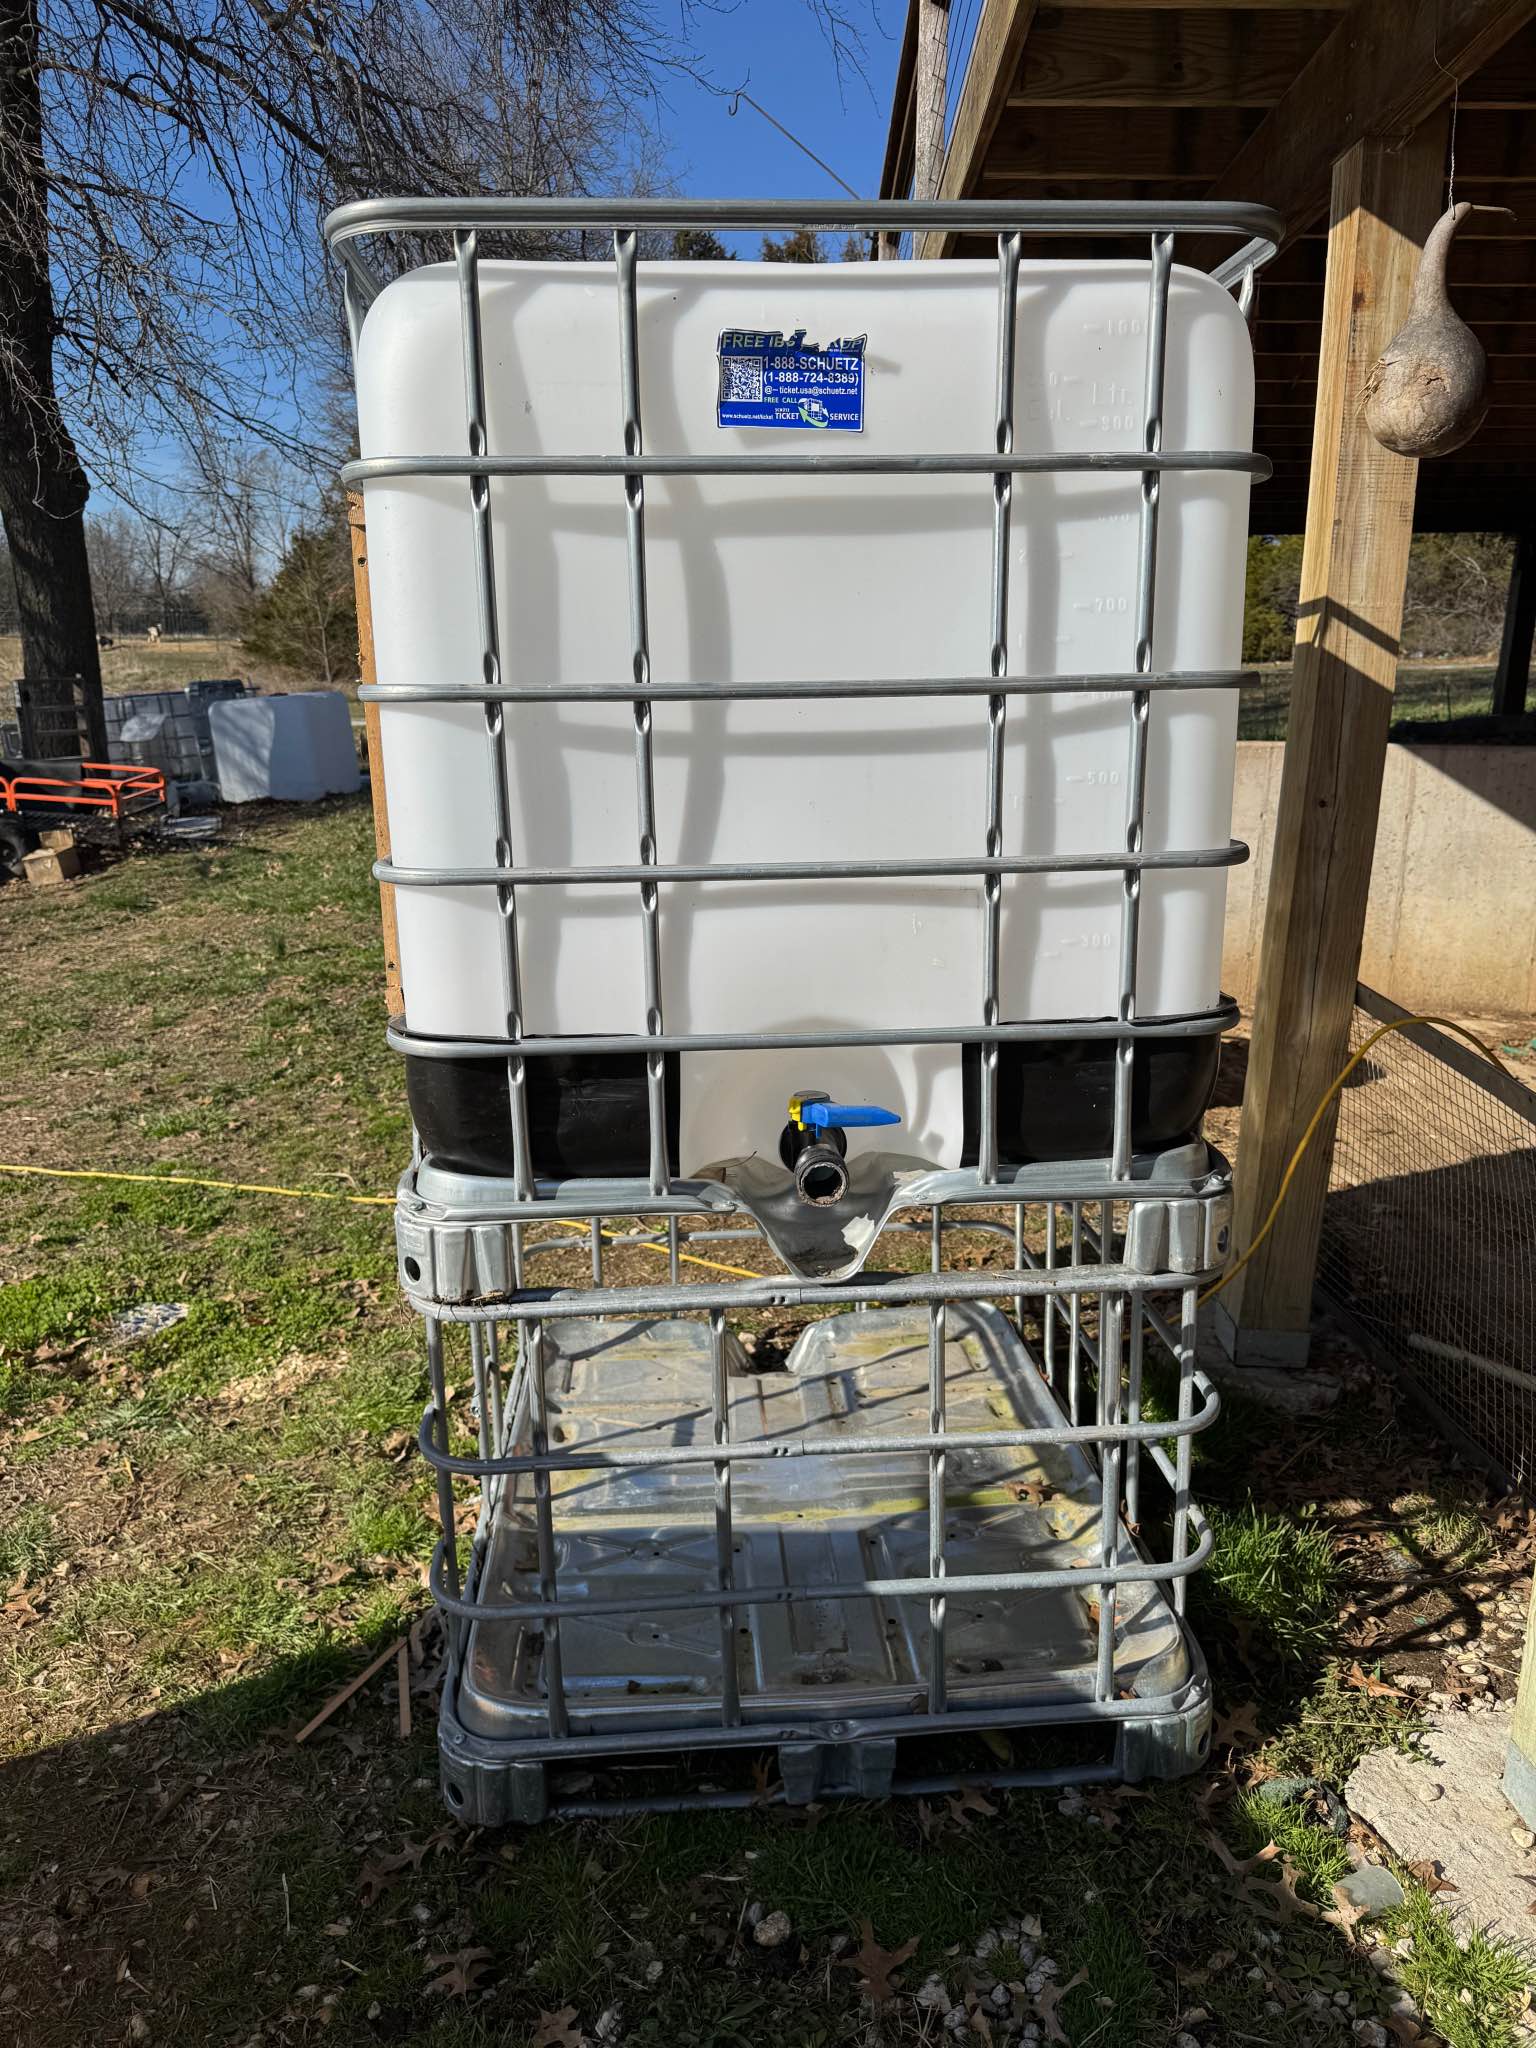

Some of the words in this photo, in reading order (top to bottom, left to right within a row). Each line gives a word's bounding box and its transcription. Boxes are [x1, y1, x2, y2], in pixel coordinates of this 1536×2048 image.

[722, 334, 765, 348] FREE
[763, 356, 859, 371] 1-888-SCHUETZ
[763, 371, 859, 386] (1-888-724-8389)
[830, 413, 859, 421] SERVICE
[1088, 772, 1119, 785] 500
